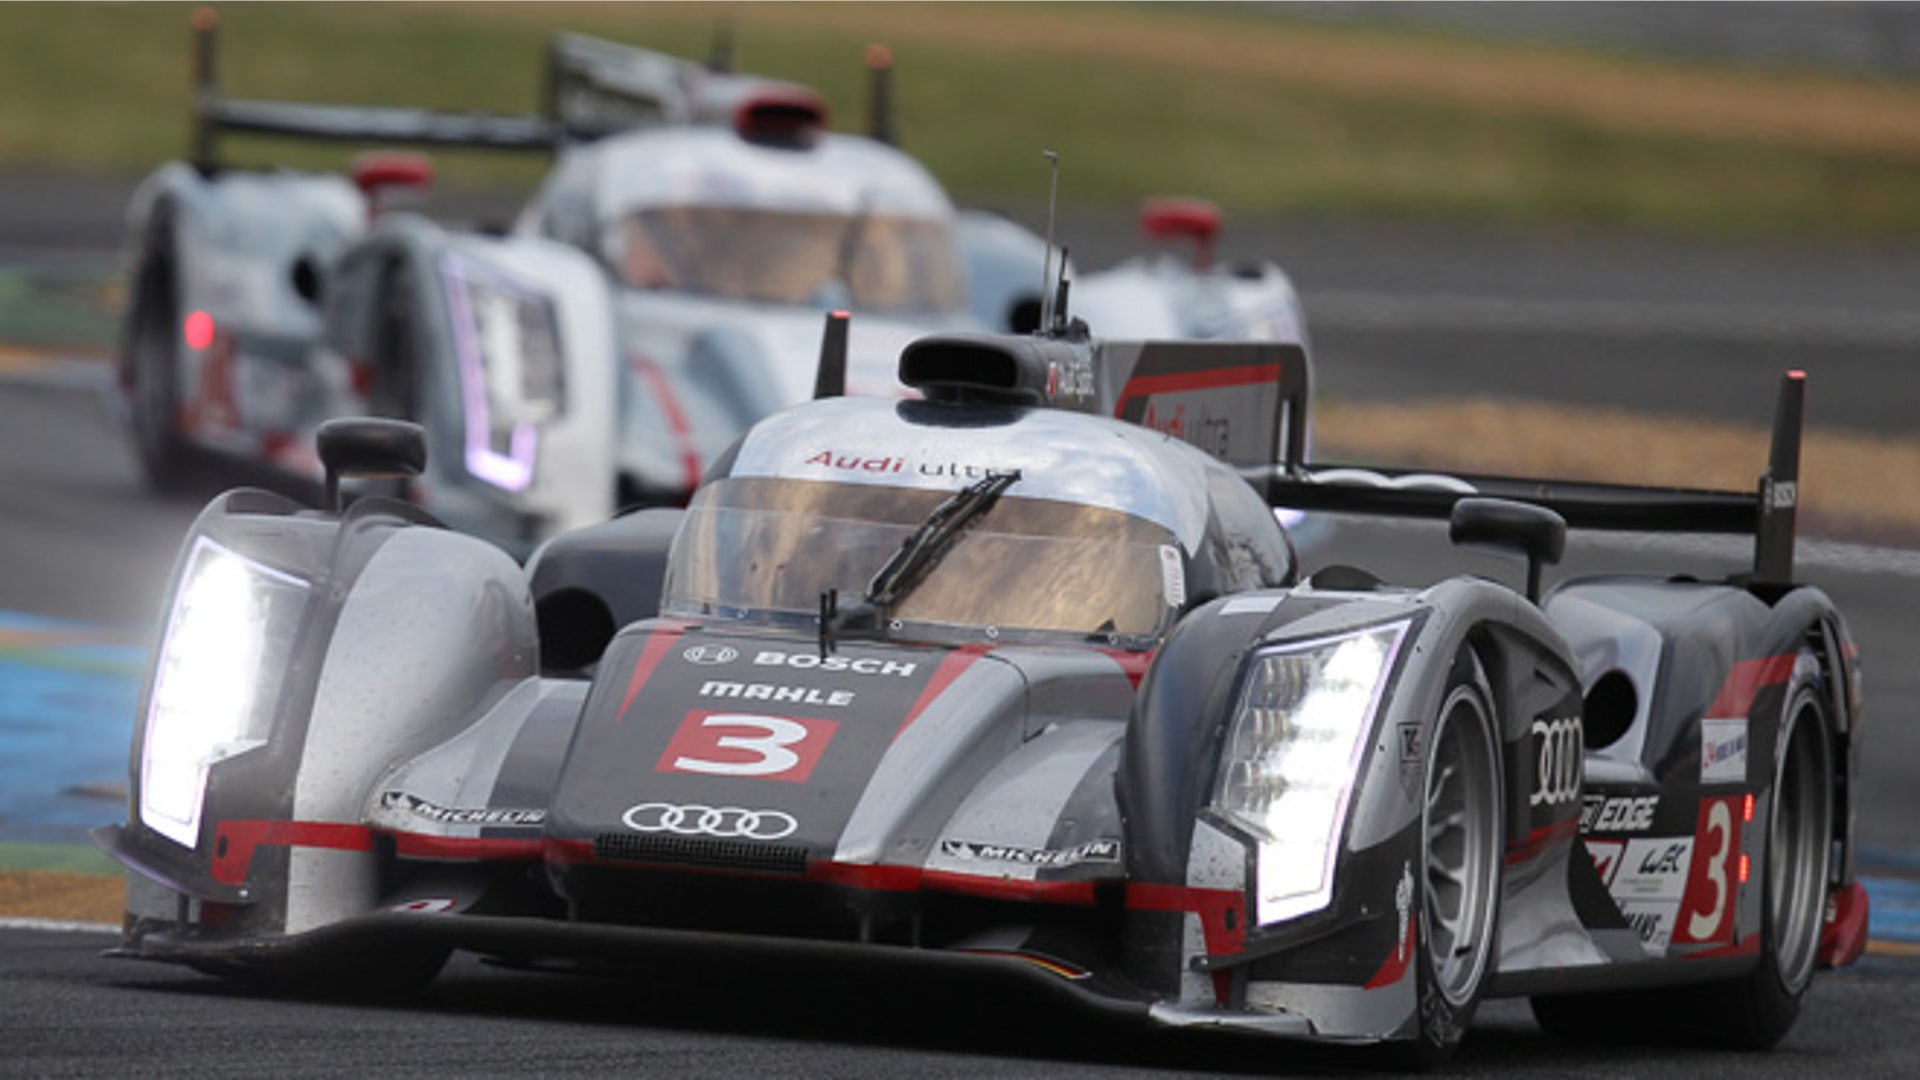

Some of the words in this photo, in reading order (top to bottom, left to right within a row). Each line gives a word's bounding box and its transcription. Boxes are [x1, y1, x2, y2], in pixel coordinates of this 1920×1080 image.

[805, 450, 904, 474] Audi
[753, 651, 917, 678] BOSCH
[699, 680, 856, 706] MAHLE
[674, 713, 808, 776] 3
[416, 801, 547, 825] MICHELIN
[1593, 795, 1661, 832] EDGE
[979, 842, 1113, 865] MICHELIN
[1687, 800, 1731, 941] 3
